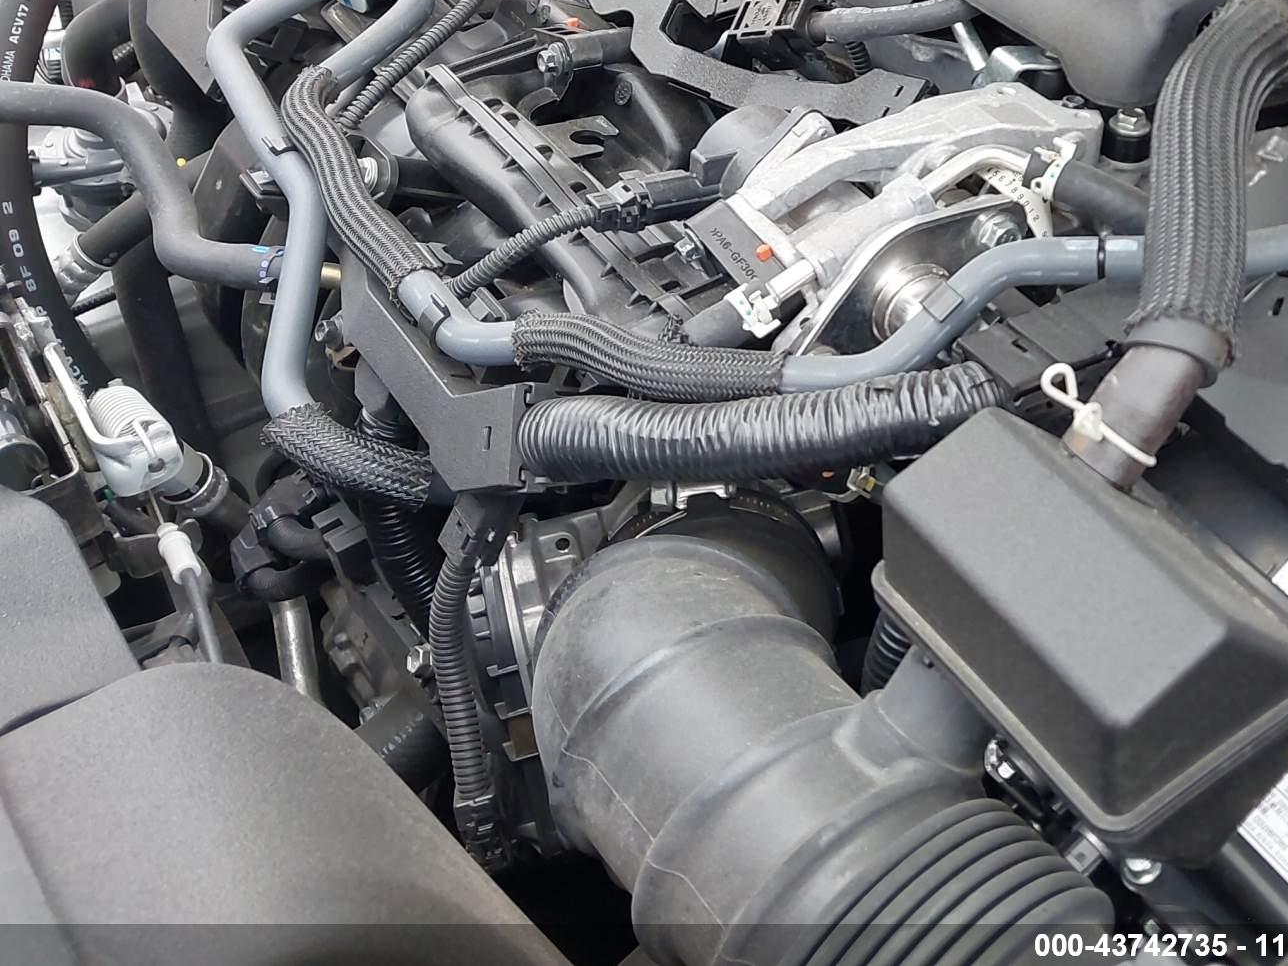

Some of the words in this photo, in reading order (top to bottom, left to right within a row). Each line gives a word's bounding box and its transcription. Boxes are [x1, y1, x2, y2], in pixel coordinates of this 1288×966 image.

[9, 4, 29, 44] ACV17
[2, 201, 13, 215] 2
[8, 229, 24, 258] 09
